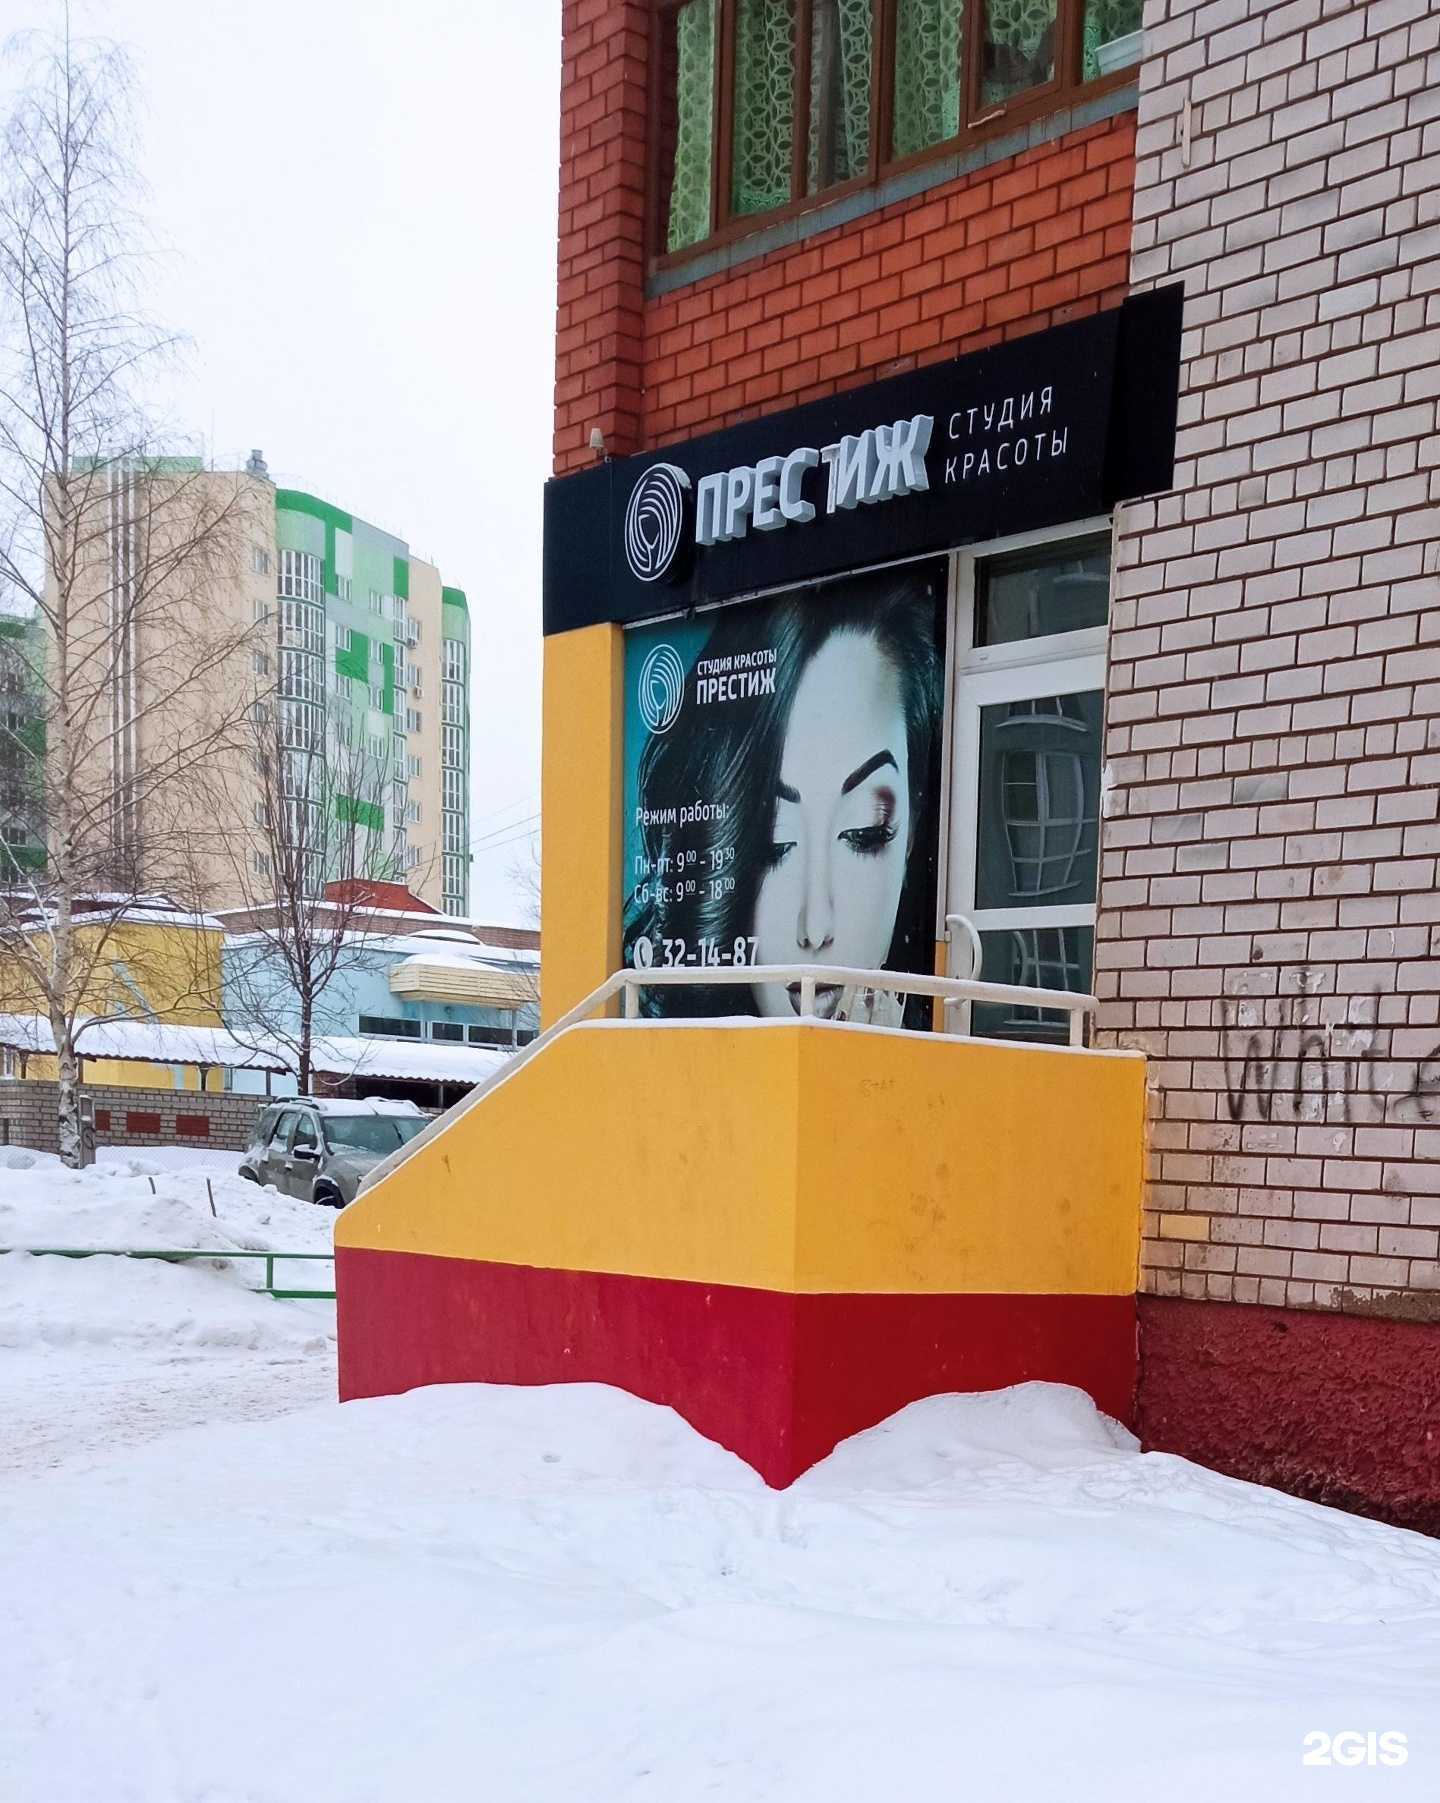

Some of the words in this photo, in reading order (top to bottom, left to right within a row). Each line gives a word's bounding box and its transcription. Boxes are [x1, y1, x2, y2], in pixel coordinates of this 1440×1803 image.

[948, 385, 1054, 440] СТУДИЯ
[944, 426, 1069, 484] КРАСОТЫ
[695, 413, 935, 546] ПРЕСТИЖ
[697, 655, 732, 676] СТУДИЯ
[733, 648, 778, 670] КРАСОТЫ
[696, 667, 777, 705] ПРЕСТИЖ
[635, 806, 677, 826] Режим
[679, 799, 730, 828] работы:
[661, 936, 759, 968] 32-14-87
